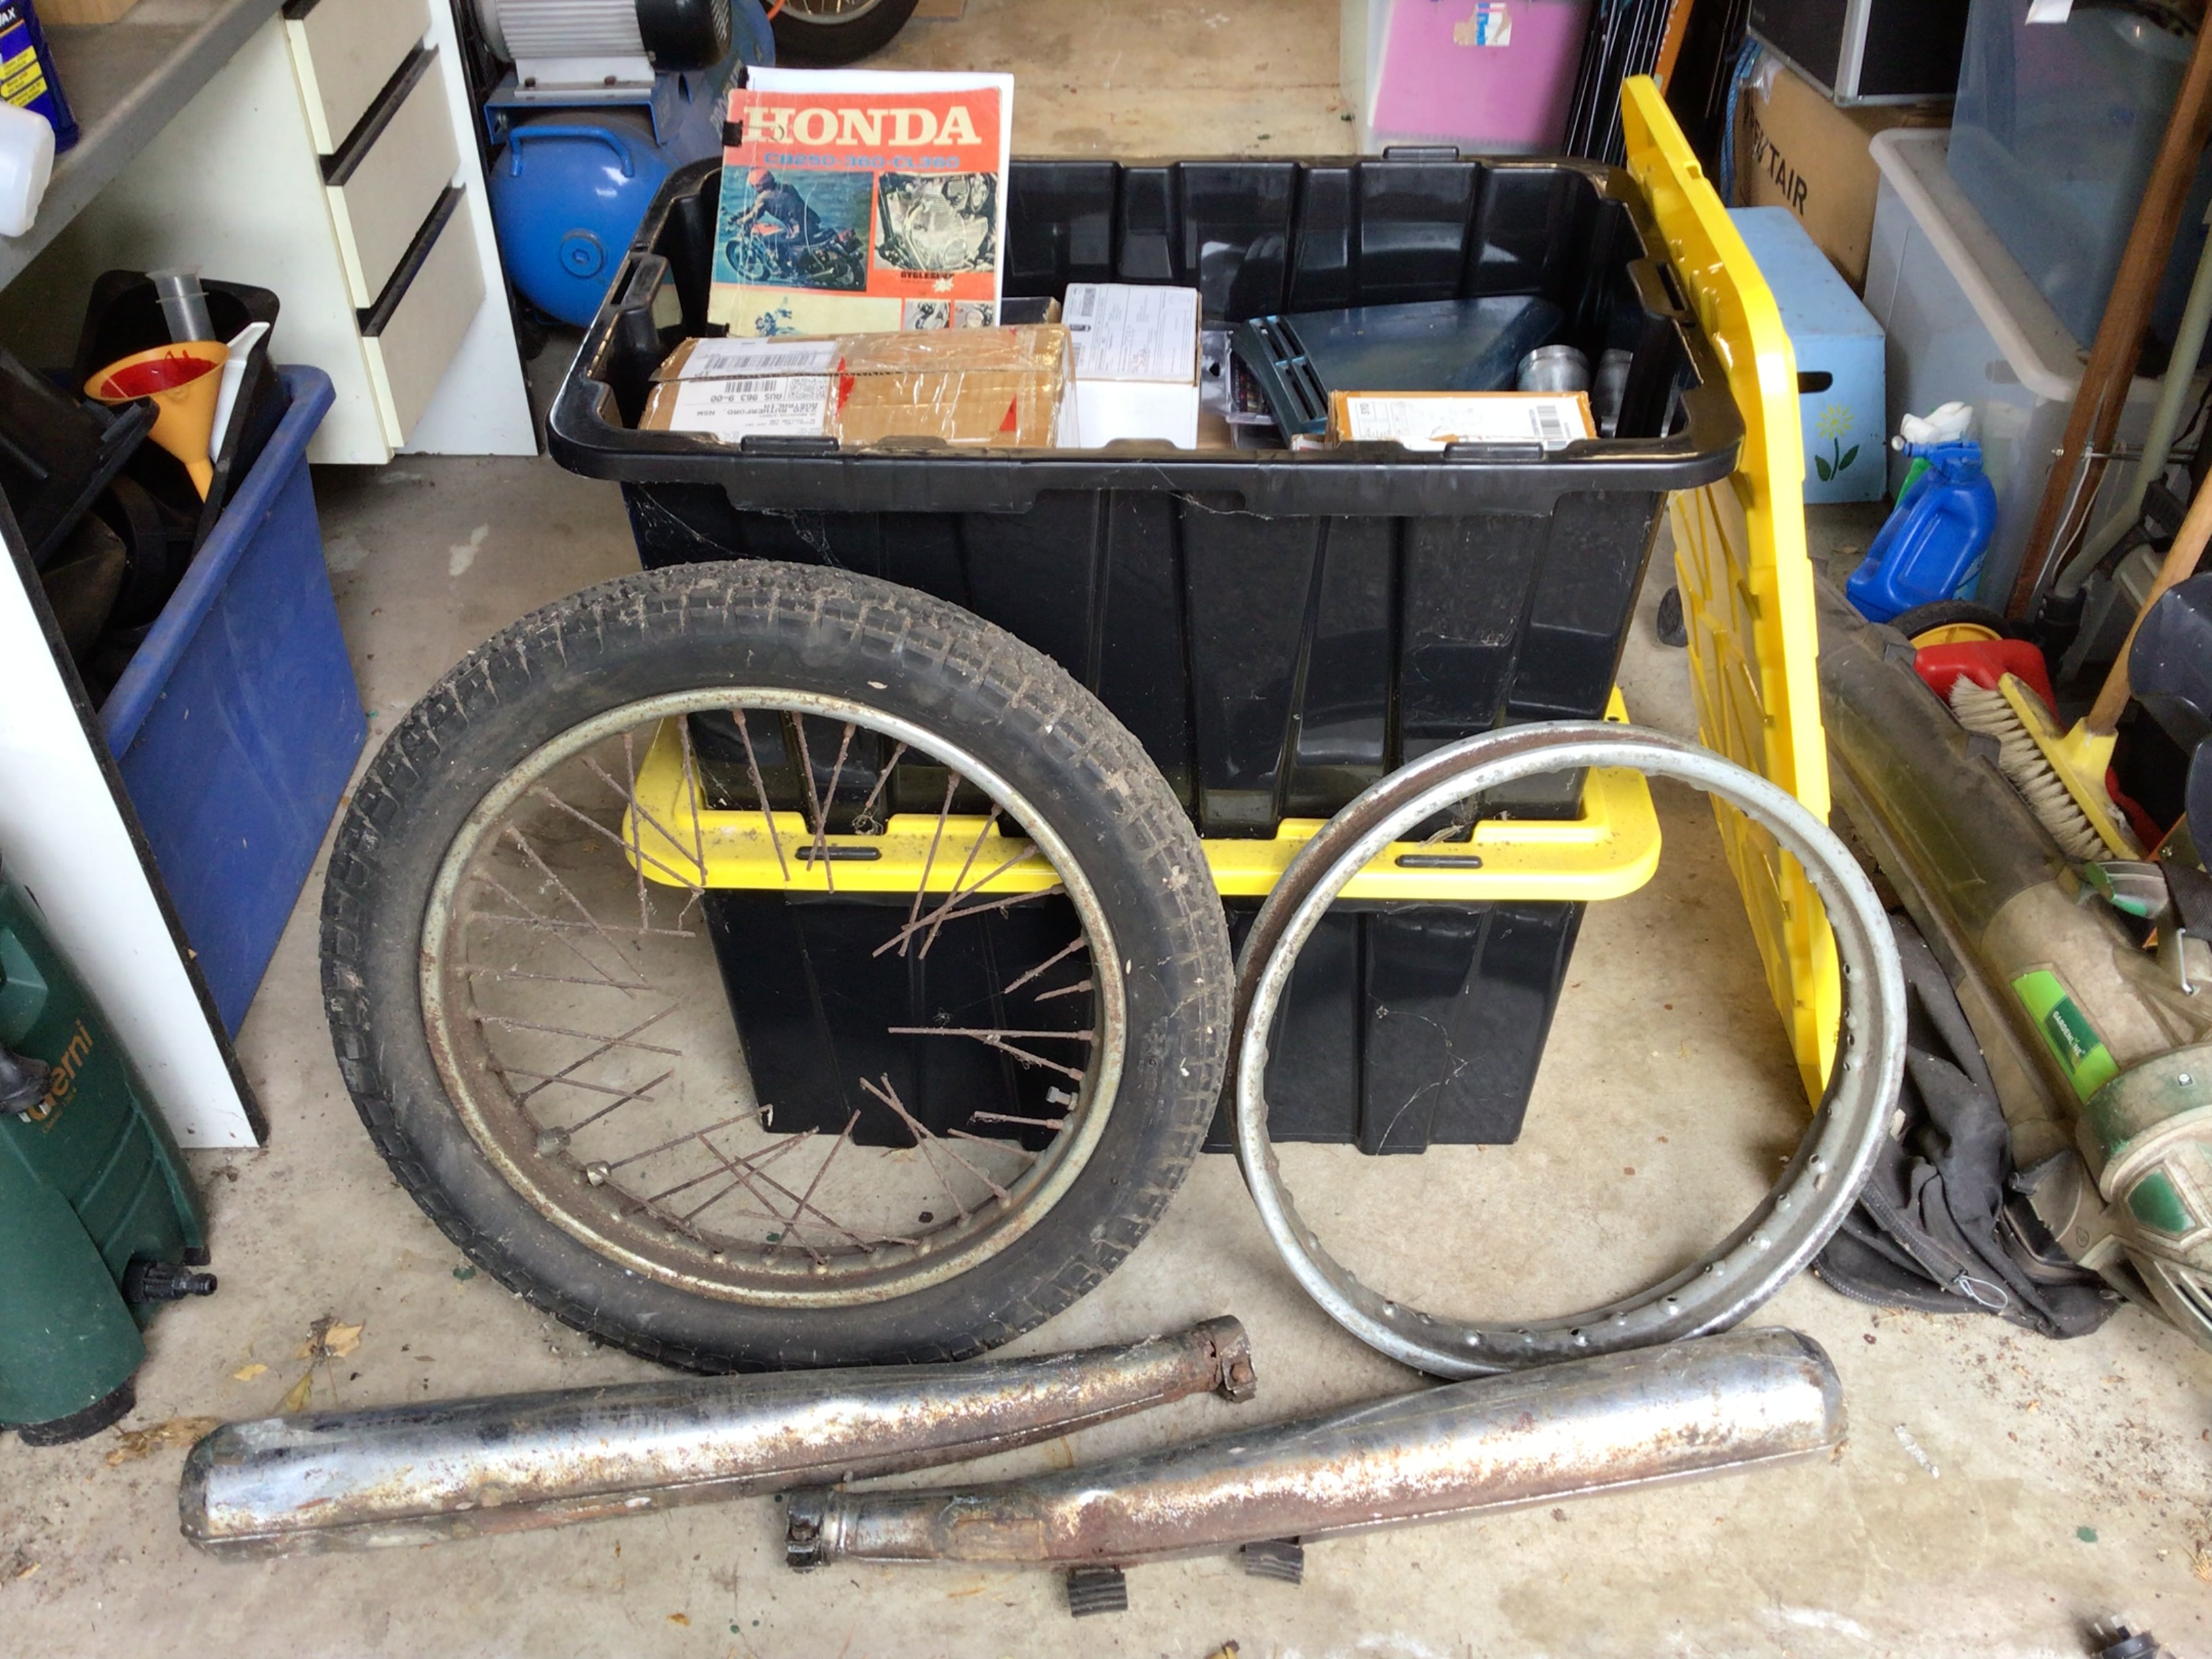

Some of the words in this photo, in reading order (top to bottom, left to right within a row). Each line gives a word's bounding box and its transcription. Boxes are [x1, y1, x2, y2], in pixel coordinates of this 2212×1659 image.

[741, 106, 982, 146] HONDA
[740, 394, 758, 402] 963
[764, 392, 783, 401] AUS
